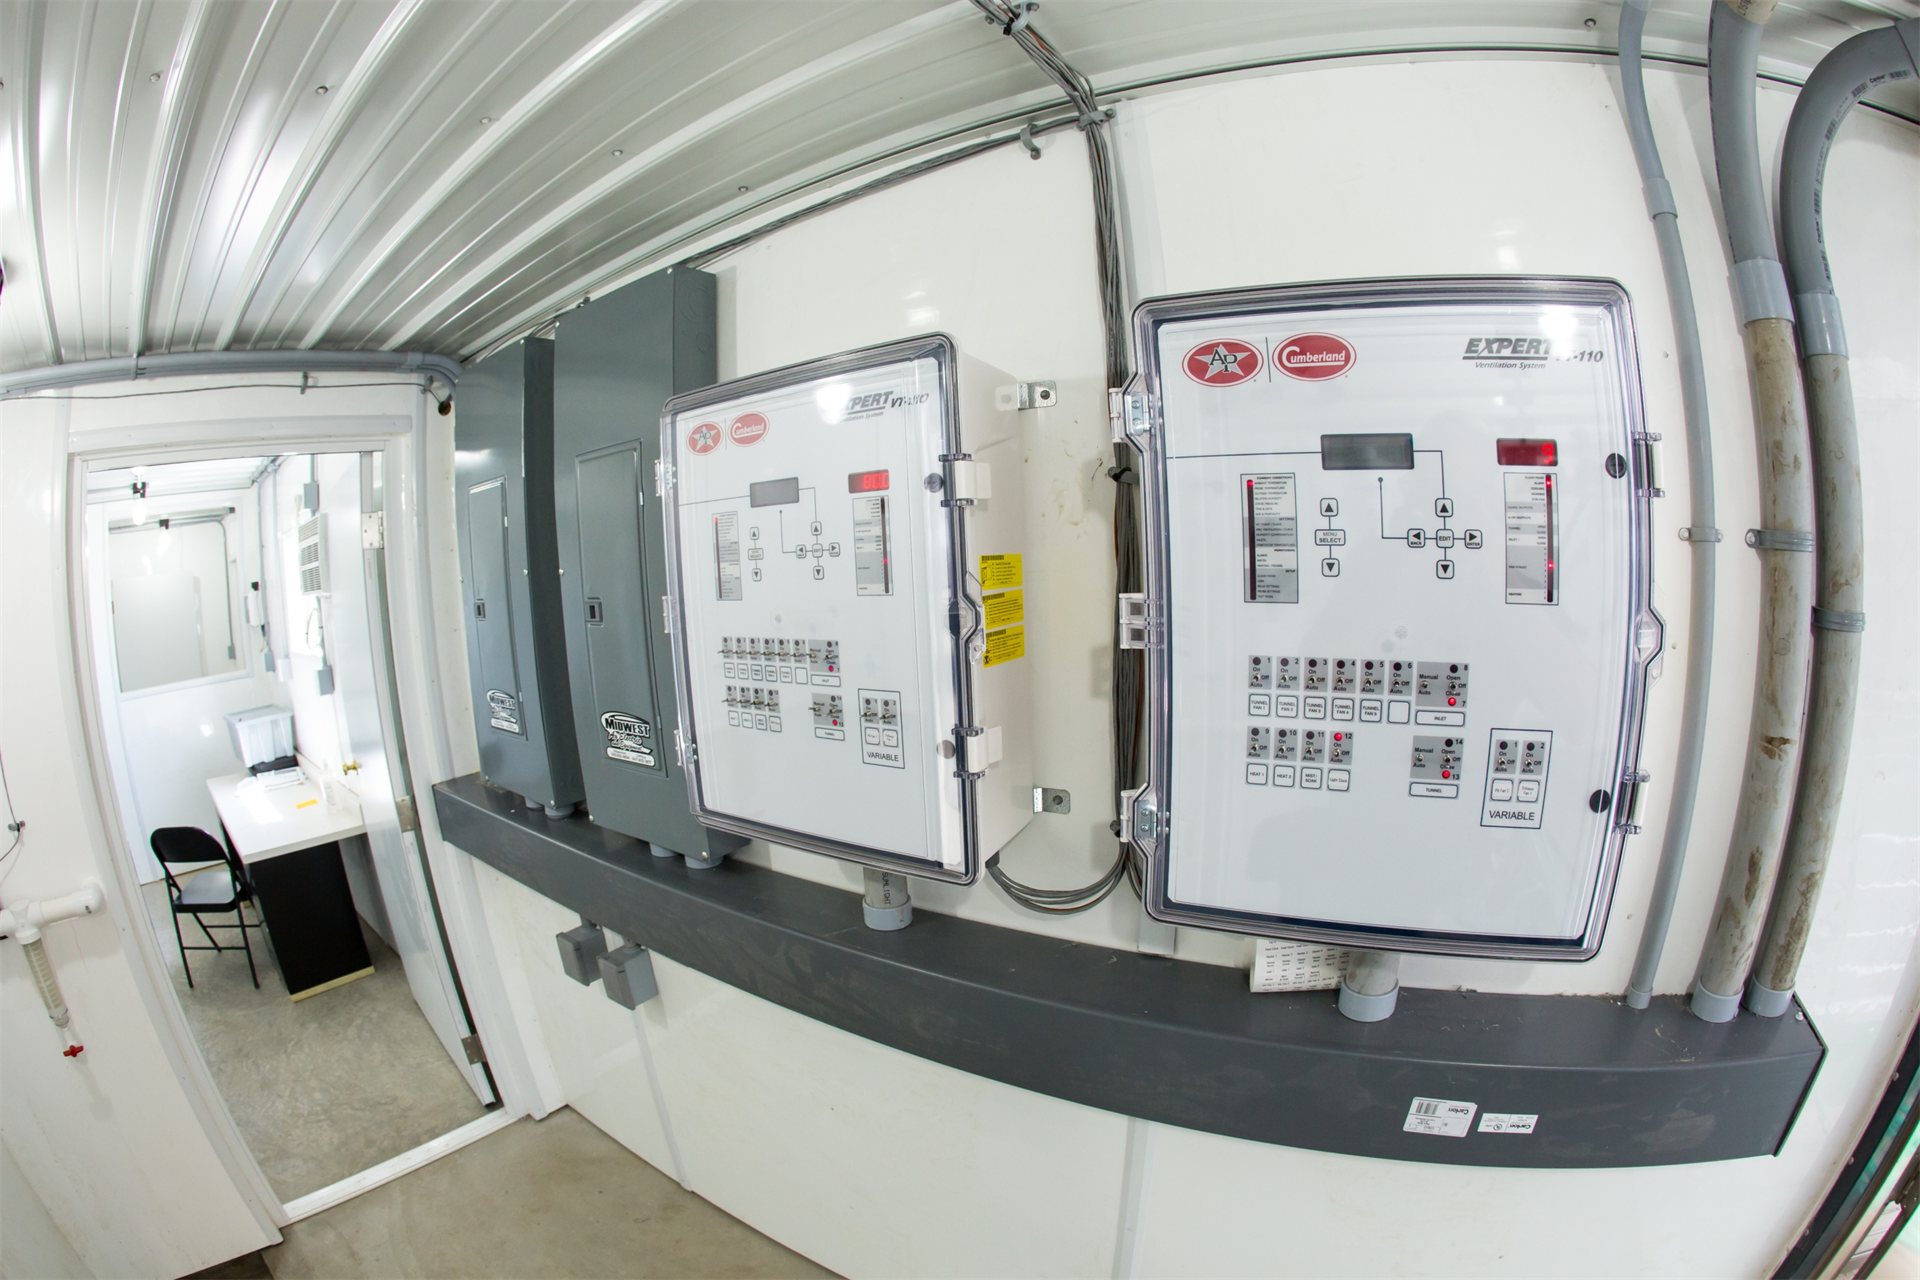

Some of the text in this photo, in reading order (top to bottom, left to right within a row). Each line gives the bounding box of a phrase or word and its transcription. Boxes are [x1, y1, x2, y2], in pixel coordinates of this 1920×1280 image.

[1282, 345, 1346, 368] Cumberland
[1464, 337, 1604, 363] EXPERT -110
[1210, 348, 1239, 373] AP
[1475, 361, 1546, 370] Ventilation System
[699, 430, 712, 445] AP
[604, 717, 649, 736] MIDWEST
[866, 751, 899, 762] VARIABLE
[1489, 810, 1535, 821] VARIABLE
